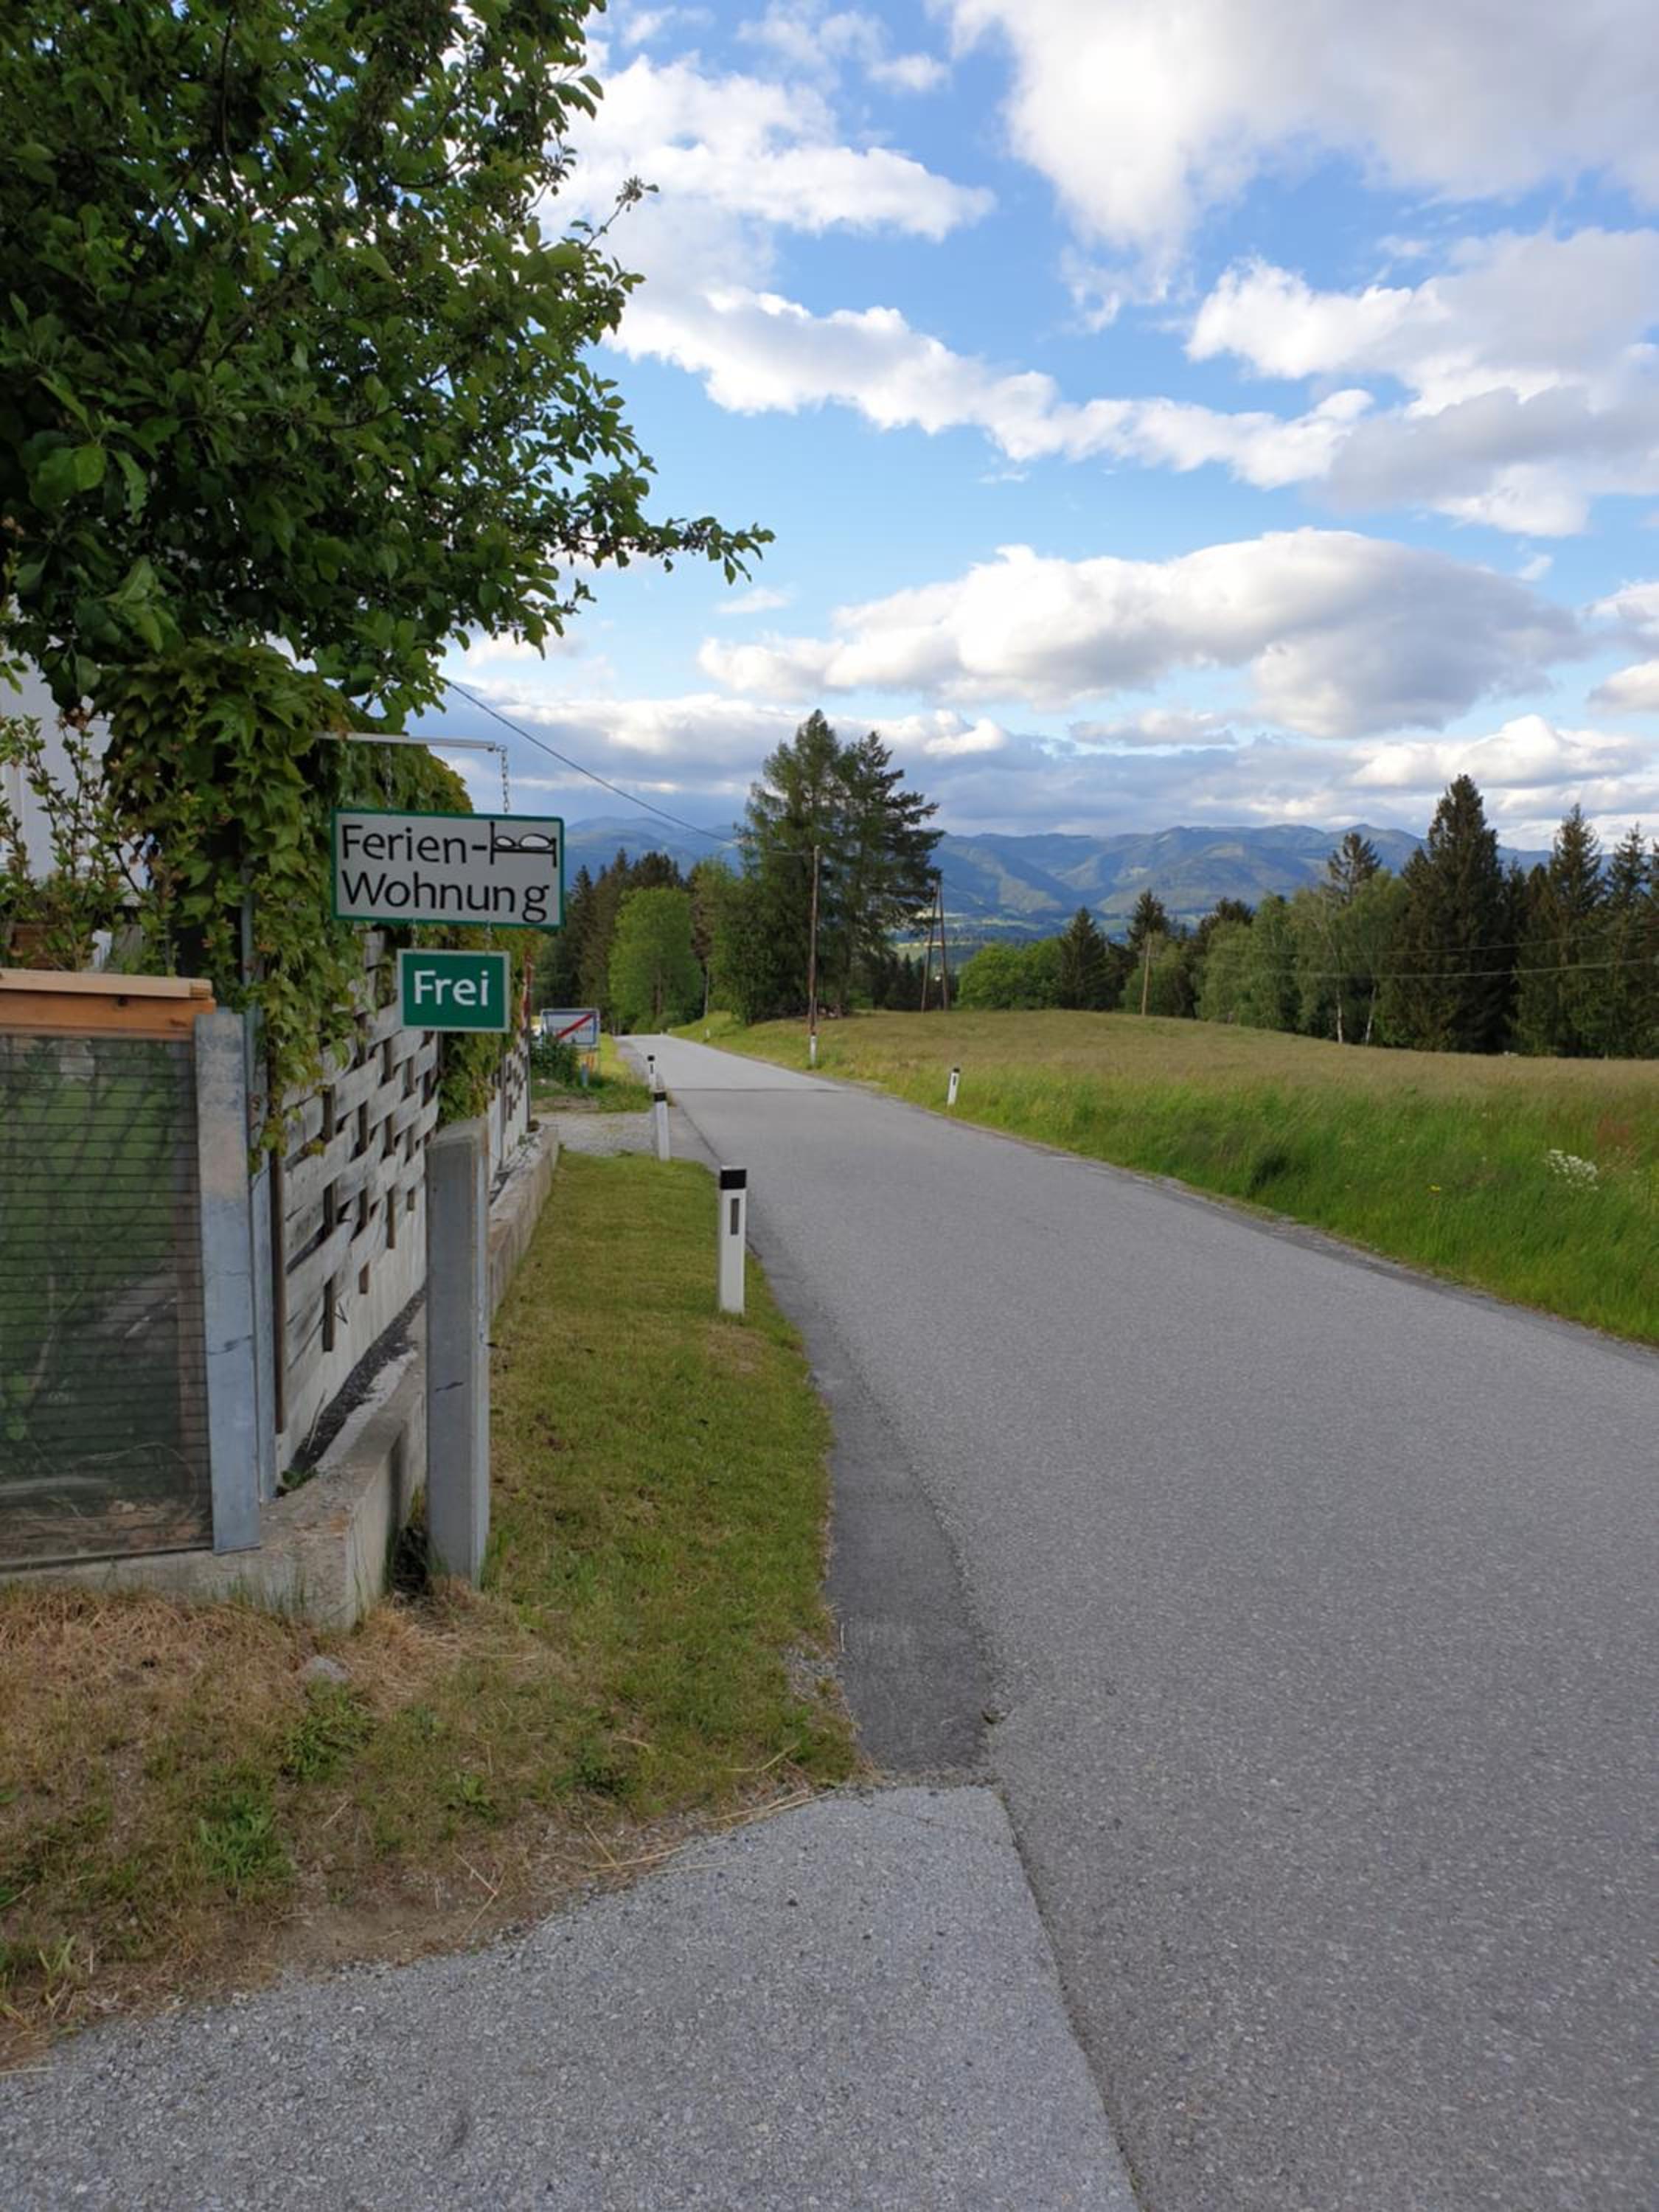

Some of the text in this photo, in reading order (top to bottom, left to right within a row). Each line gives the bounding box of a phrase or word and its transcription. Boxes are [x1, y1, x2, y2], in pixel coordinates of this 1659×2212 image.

[341, 824, 487, 864] Ferien-
[341, 869, 550, 922] Wohnung
[414, 970, 489, 1006] Frei
